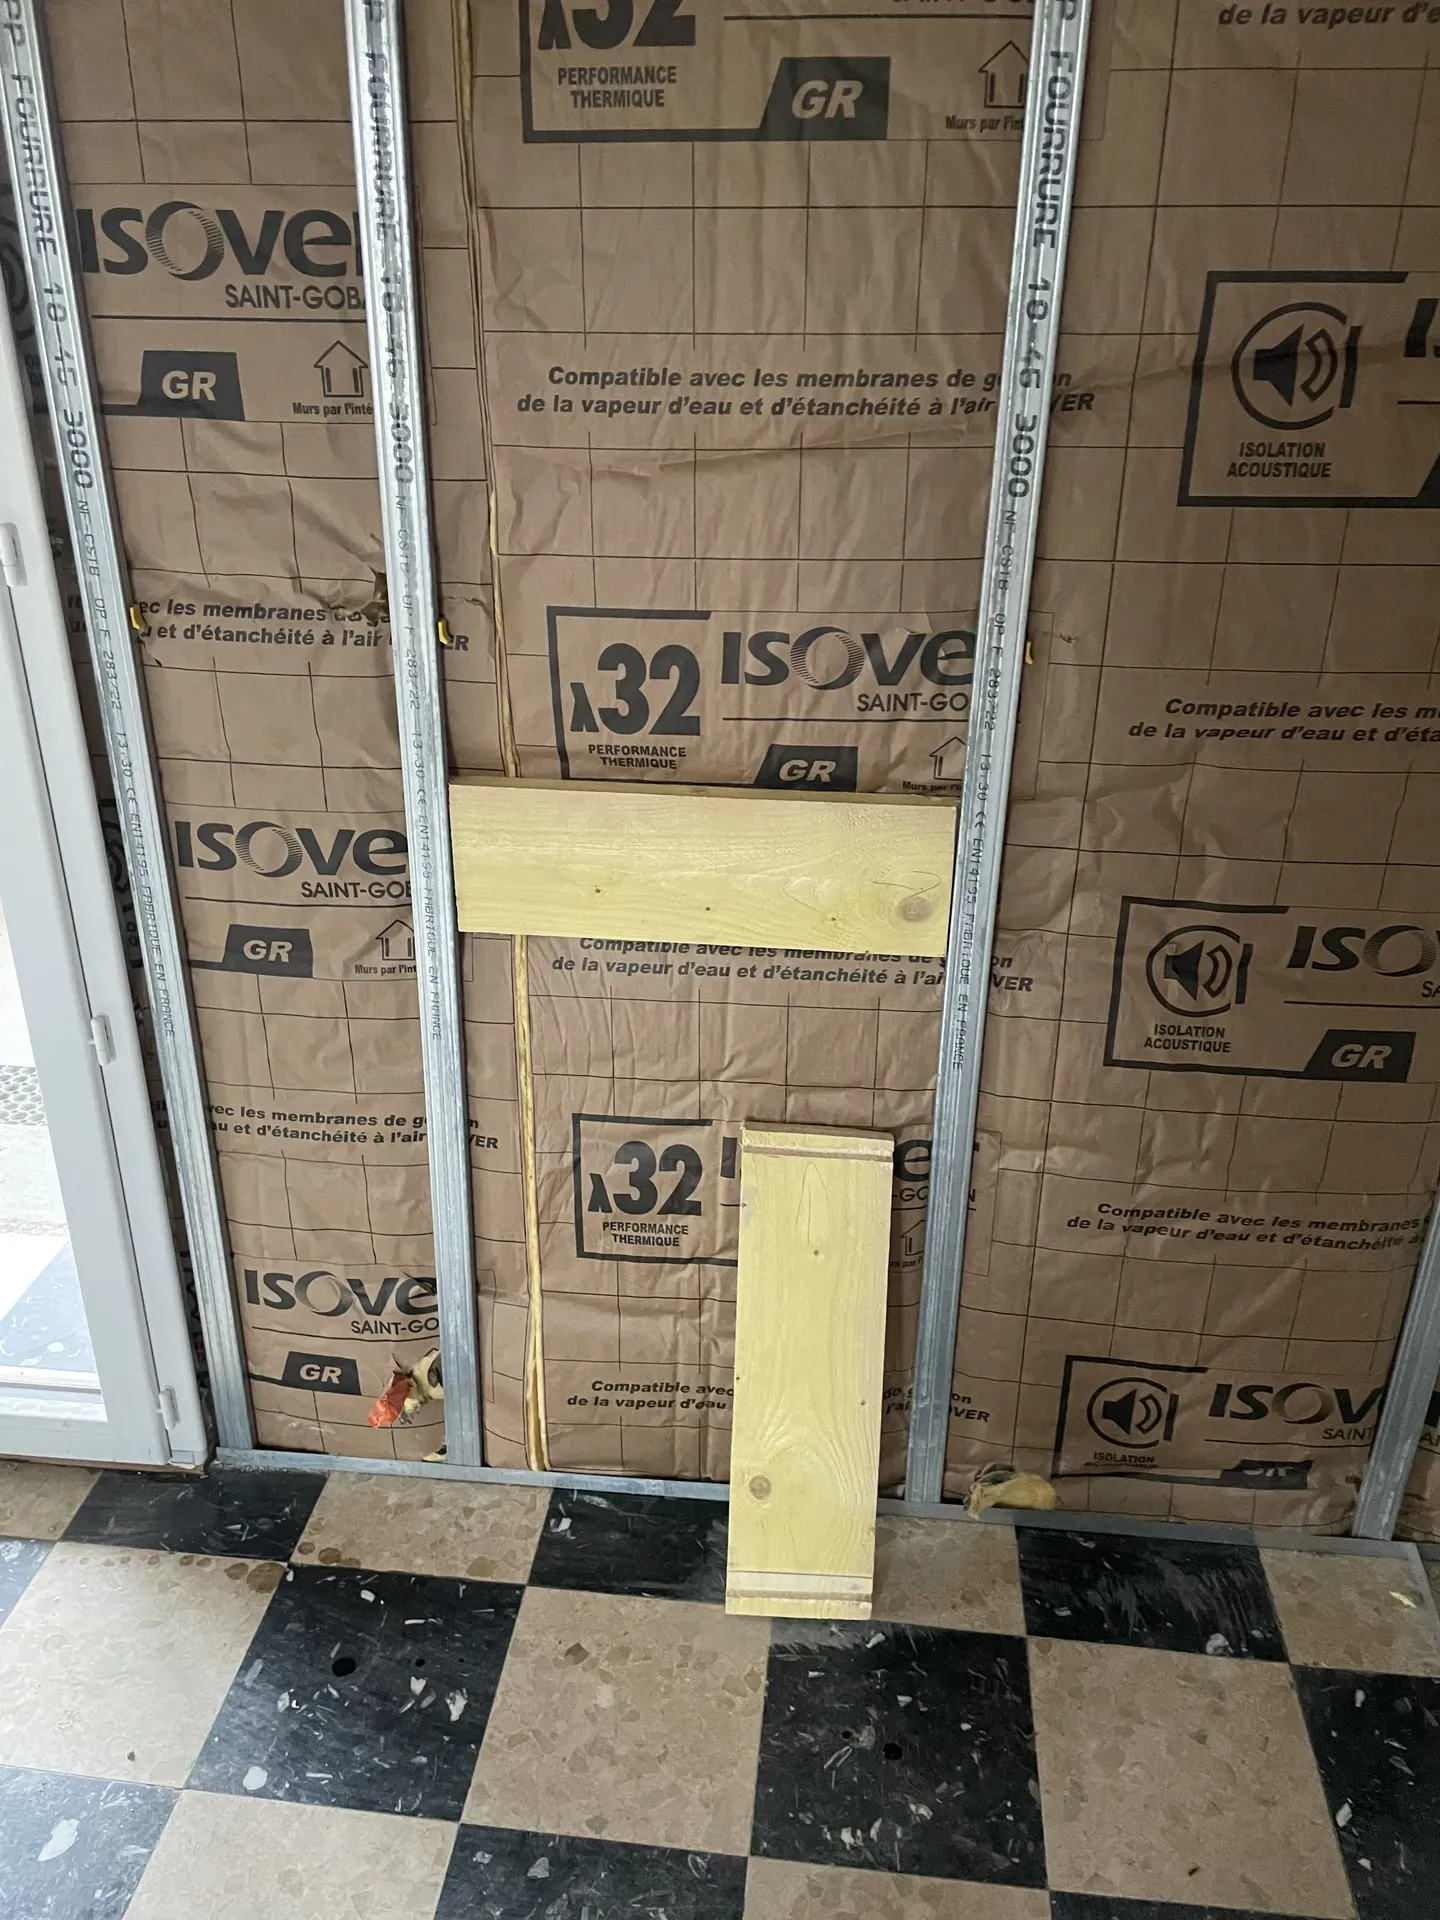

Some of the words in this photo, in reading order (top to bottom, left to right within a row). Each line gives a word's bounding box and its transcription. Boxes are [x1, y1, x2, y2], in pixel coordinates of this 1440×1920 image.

[1218, 4, 1252, 25] de
[1260, 3, 1287, 25] la
[1298, 6, 1396, 29] vapeur
[1402, 2, 1440, 24] d'e
[558, 65, 677, 86] PERFORMANCE
[570, 89, 665, 109] THERMIQUE
[792, 79, 864, 120] GR
[1032, 50, 1074, 248] FOURRURE
[10, 74, 57, 255] FOURRURE
[364, 52, 398, 241] FOURRURE
[389, 402, 413, 483] 3000
[225, 284, 366, 310] SAINT-GOB
[162, 370, 217, 401] GR
[549, 366, 682, 389] Compatible
[689, 372, 745, 388] avec
[753, 369, 788, 388] les
[796, 369, 938, 388] membranes
[946, 369, 976, 388] de
[293, 402, 320, 415] Murs
[323, 404, 341, 417] par
[343, 403, 373, 415] l'inté
[517, 394, 545, 412] de
[553, 395, 573, 412] la
[581, 399, 662, 417] vapeur
[668, 396, 731, 415] d'eau
[739, 397, 763, 415] et
[771, 397, 920, 416] d'étanchéité
[928, 397, 942, 415] à
[950, 397, 996, 415] l'air
[63, 409, 93, 488] 3000
[1007, 414, 1037, 497] 3000
[1239, 442, 1326, 458] ISOLATION
[1227, 462, 1332, 478] ACOUSTIQUE
[167, 599, 196, 615] les
[203, 603, 326, 621] membranes
[157, 626, 176, 638] et
[183, 624, 315, 645] d'étanchéité
[321, 629, 334, 645] à
[342, 629, 383, 647] l'air
[721, 626, 976, 691] ISOVe
[857, 692, 969, 712] SAINT-GO
[1165, 698, 1300, 720] Compatible
[1307, 705, 1364, 718] avec
[1371, 702, 1409, 718] les
[1128, 722, 1157, 738] de
[1164, 723, 1186, 738] la
[1194, 727, 1276, 740] vapeur
[1281, 726, 1343, 741] d'eau
[1352, 727, 1378, 741] et
[588, 744, 686, 758] PERFORMANCE
[601, 755, 677, 770] THERMIQUE
[779, 759, 836, 783] GR
[903, 781, 927, 791] Murs
[174, 821, 407, 877] ISOVe
[301, 881, 411, 899] SAINT-GO
[140, 885, 161, 954] FABRIQUE
[243, 940, 293, 962] GR
[579, 938, 690, 954] Compatible
[696, 945, 742, 955] avec
[748, 947, 777, 957] les
[154, 963, 165, 980] EN
[355, 965, 378, 974] Murs
[381, 966, 396, 976] par
[552, 957, 575, 970] de
[581, 958, 599, 971] la
[605, 961, 673, 976] vapeur
[677, 962, 730, 977] d'eau
[736, 965, 758, 978] et
[763, 965, 887, 984] d'étanchéité
[894, 970, 905, 983] à
[913, 971, 944, 985] l'ai
[992, 975, 1033, 992] VER
[158, 989, 175, 1036] FRANCE
[957, 993, 968, 1010] EN
[1154, 1023, 1225, 1039] ISOLATION
[952, 1019, 967, 1070] FRANCE
[1144, 1037, 1231, 1053] ACOUSTIQUE
[1331, 1043, 1392, 1069] GR
[240, 1106, 266, 1119] les
[272, 1112, 377, 1126] membranes
[384, 1115, 406, 1126] de
[234, 1124, 251, 1135] et
[257, 1125, 367, 1143] d'étanchéité
[373, 1132, 384, 1143] à
[391, 1132, 426, 1143] l'air
[603, 1221, 688, 1236] PERFORMANCE
[1097, 1203, 1211, 1221] Compatible
[1216, 1212, 1265, 1226] avec
[1308, 1218, 1420, 1232] membranes
[612, 1232, 679, 1247] THERMIQUE
[1066, 1216, 1091, 1228] de
[1097, 1219, 1115, 1231] la
[1122, 1224, 1191, 1238] vapeur
[1195, 1229, 1250, 1241] d'eau
[1256, 1233, 1278, 1243] et
[351, 1317, 439, 1335] SAINT-GO
[300, 1364, 342, 1384] GR
[591, 1381, 690, 1394] Compatible
[696, 1384, 734, 1396] avec
[567, 1396, 588, 1406] de
[593, 1397, 609, 1407] la
[615, 1399, 675, 1410] vapeur
[680, 1399, 726, 1409] d'eau
[949, 1406, 990, 1422] VER
[1094, 1452, 1155, 1463] ISOLATION
